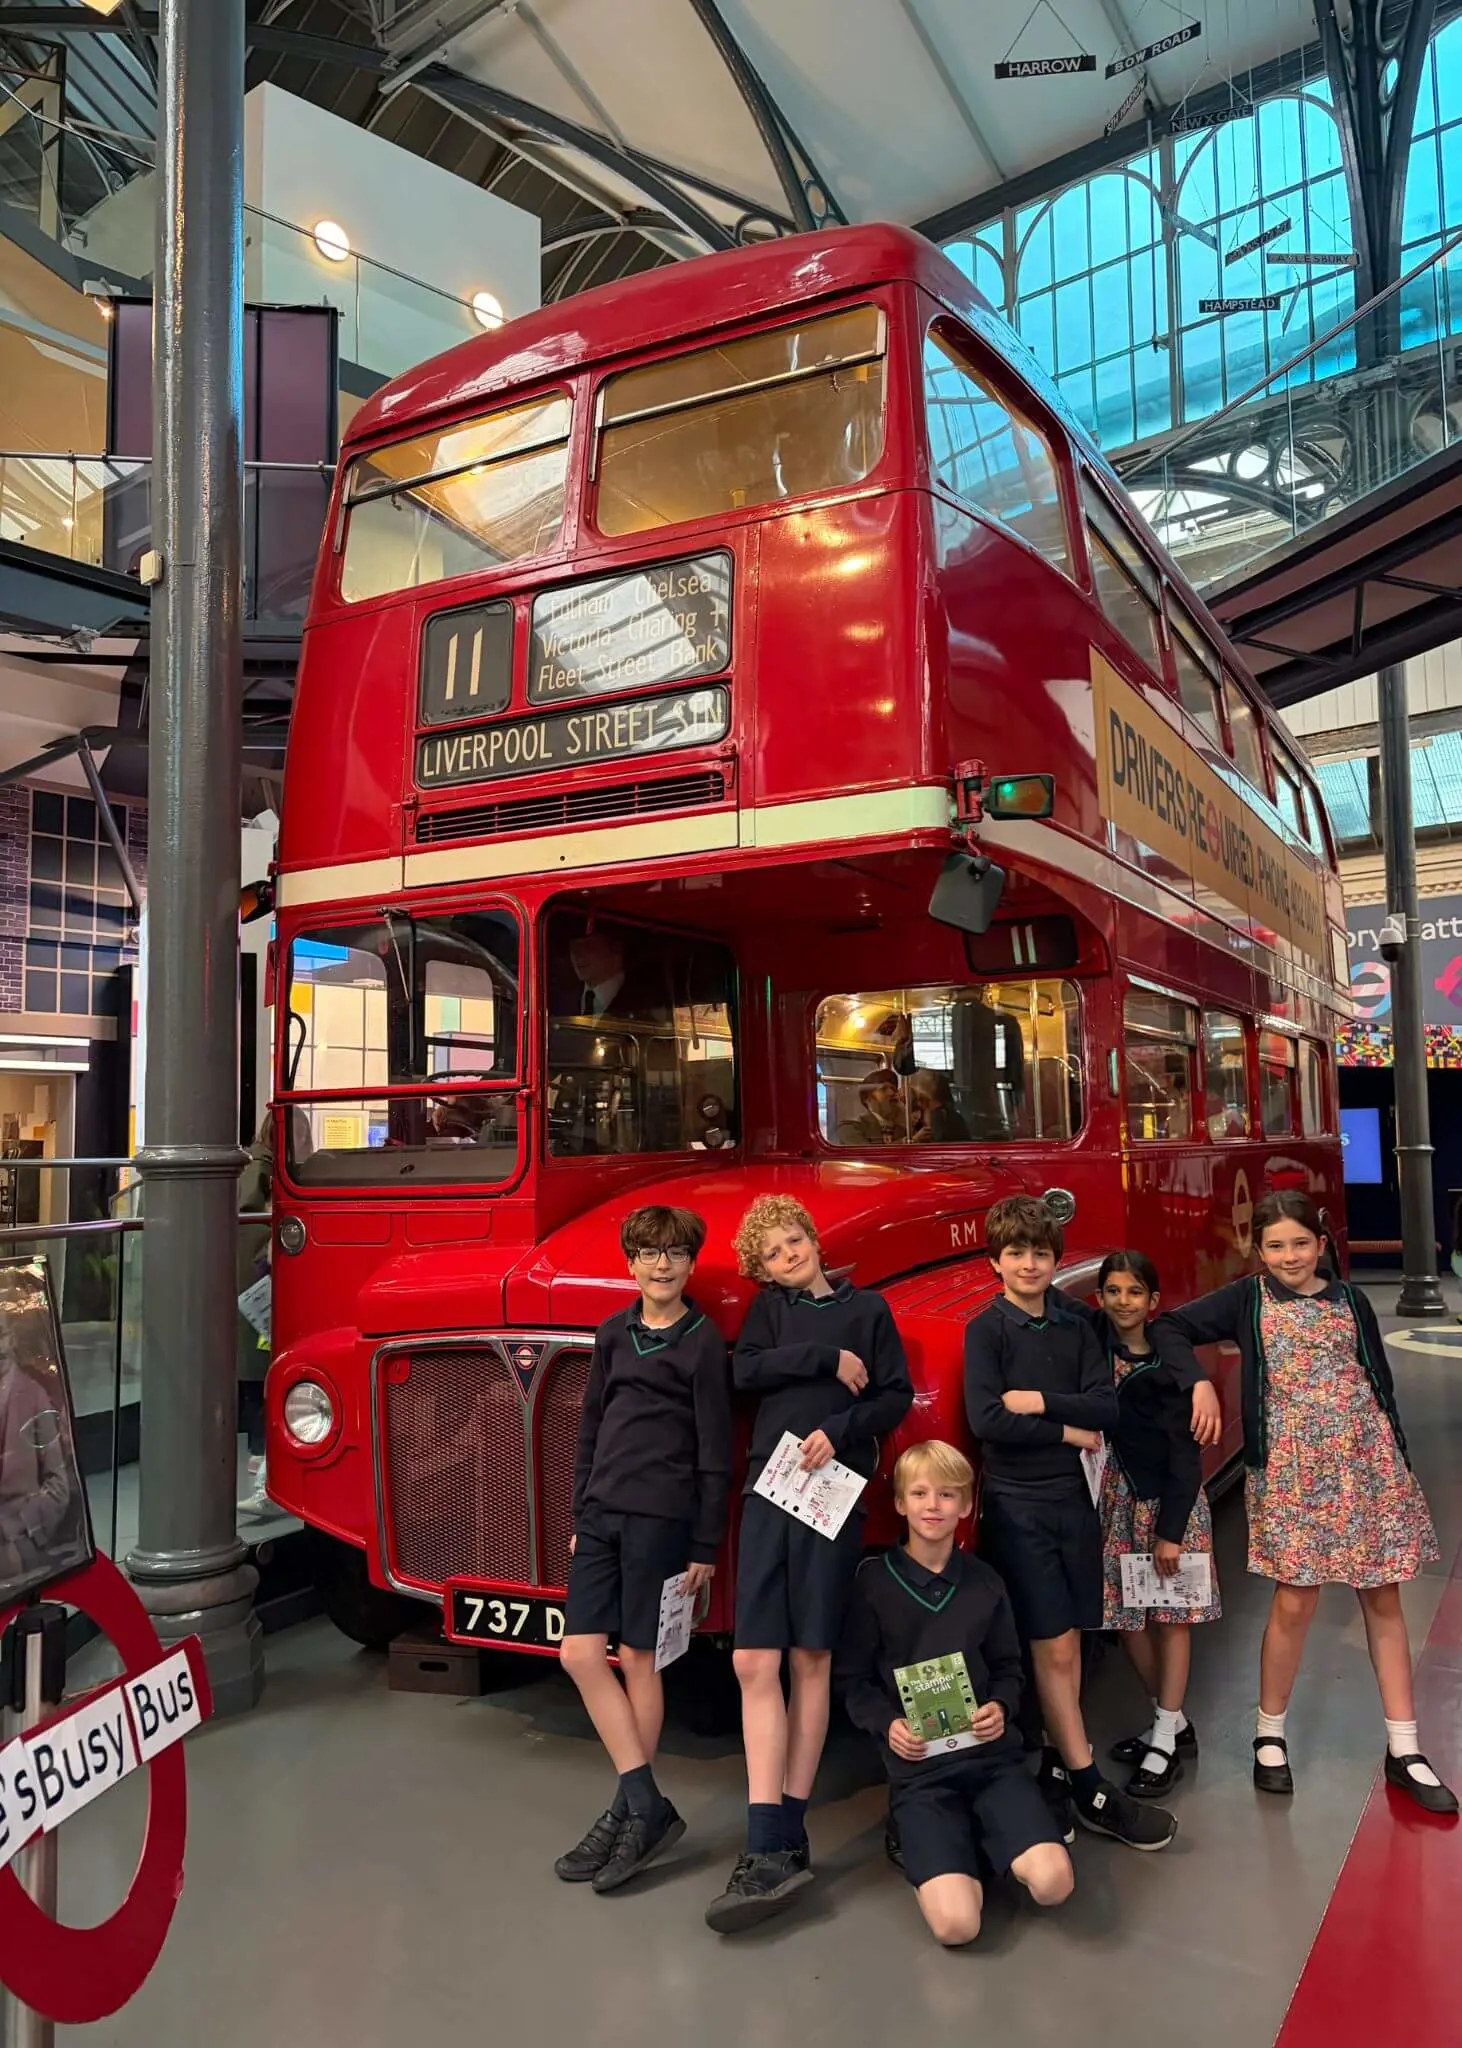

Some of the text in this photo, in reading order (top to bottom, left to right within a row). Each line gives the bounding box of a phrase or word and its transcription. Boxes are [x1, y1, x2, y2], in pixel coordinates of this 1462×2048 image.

[1008, 57, 1082, 76] HARROW
[1114, 28, 1192, 73] BOW ROAD
[1171, 106, 1249, 132] NEW X GATE
[1277, 253, 1349, 264] AYLESBURY
[1204, 299, 1275, 312] HAMPSTEAD
[550, 571, 712, 621] Fulham Chelsea
[542, 626, 612, 658] Victoria
[628, 610, 698, 641] Charing
[445, 627, 483, 700] 11
[538, 635, 717, 692] Fleet Street Bank
[423, 723, 552, 777] LIVERPOOL
[566, 705, 658, 754] STREET
[1110, 707, 1187, 838] DRIVERS
[1011, 924, 1037, 965] 11
[951, 1219, 977, 1247] RM
[464, 1597, 530, 1636] 737
[33, 1712, 124, 1809] Busy
[132, 1671, 194, 1740] Bus
